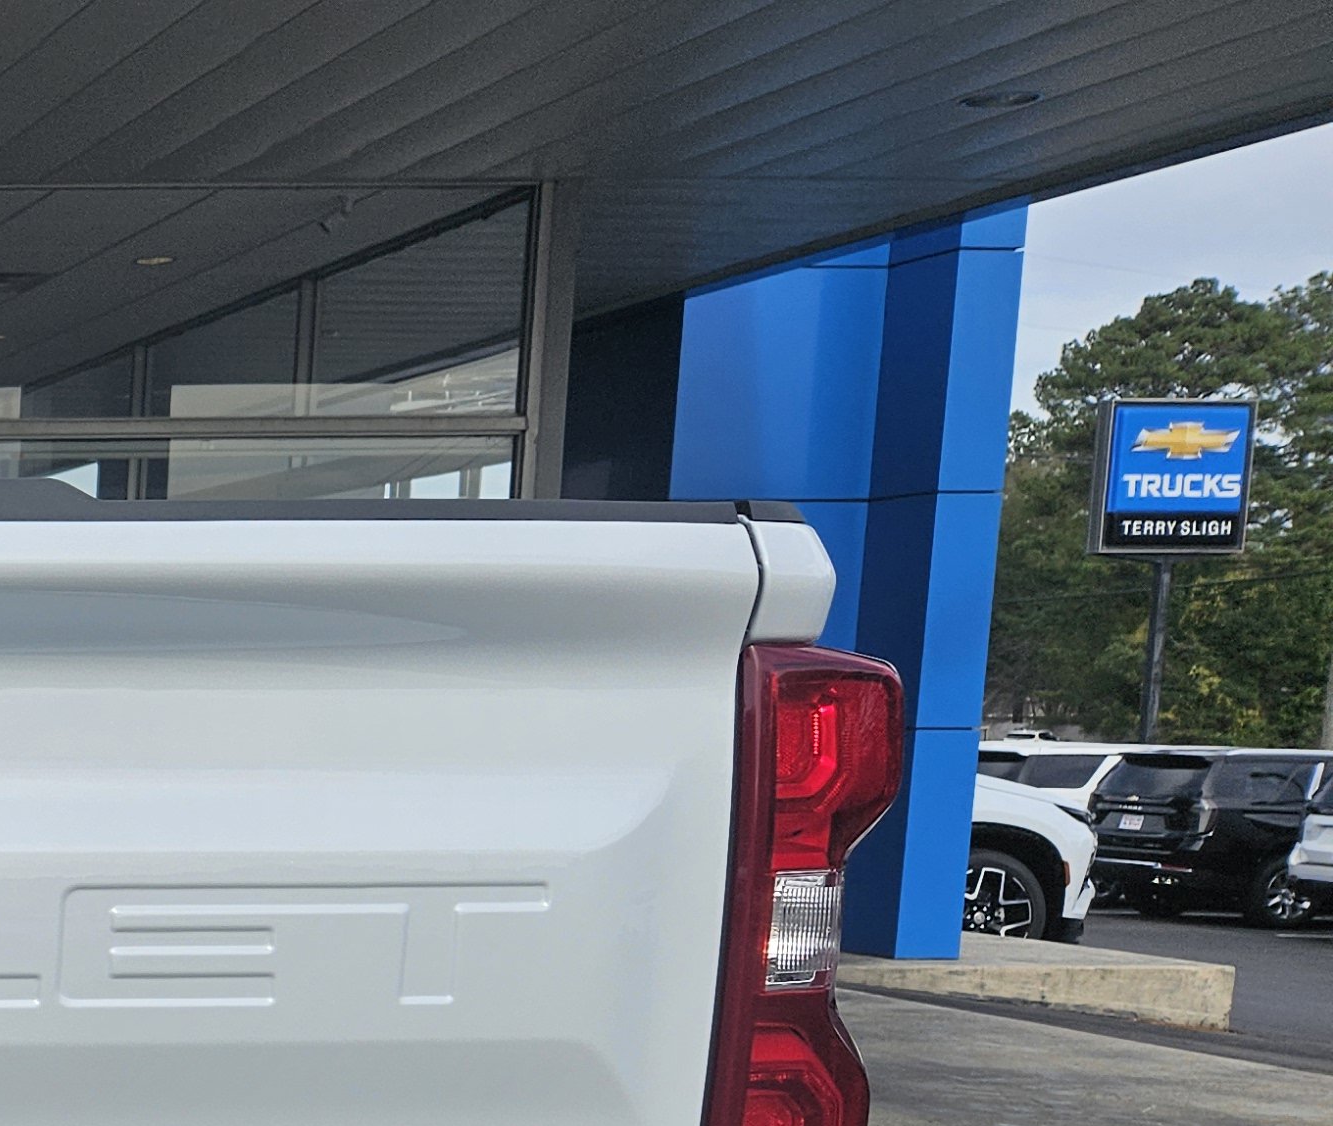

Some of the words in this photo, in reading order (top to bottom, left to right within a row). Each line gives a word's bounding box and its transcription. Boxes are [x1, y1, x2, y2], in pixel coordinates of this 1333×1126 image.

[1123, 473, 1241, 498] TRUCKS
[1122, 520, 1177, 536] TERRY
[1180, 520, 1232, 536] SLIGH
